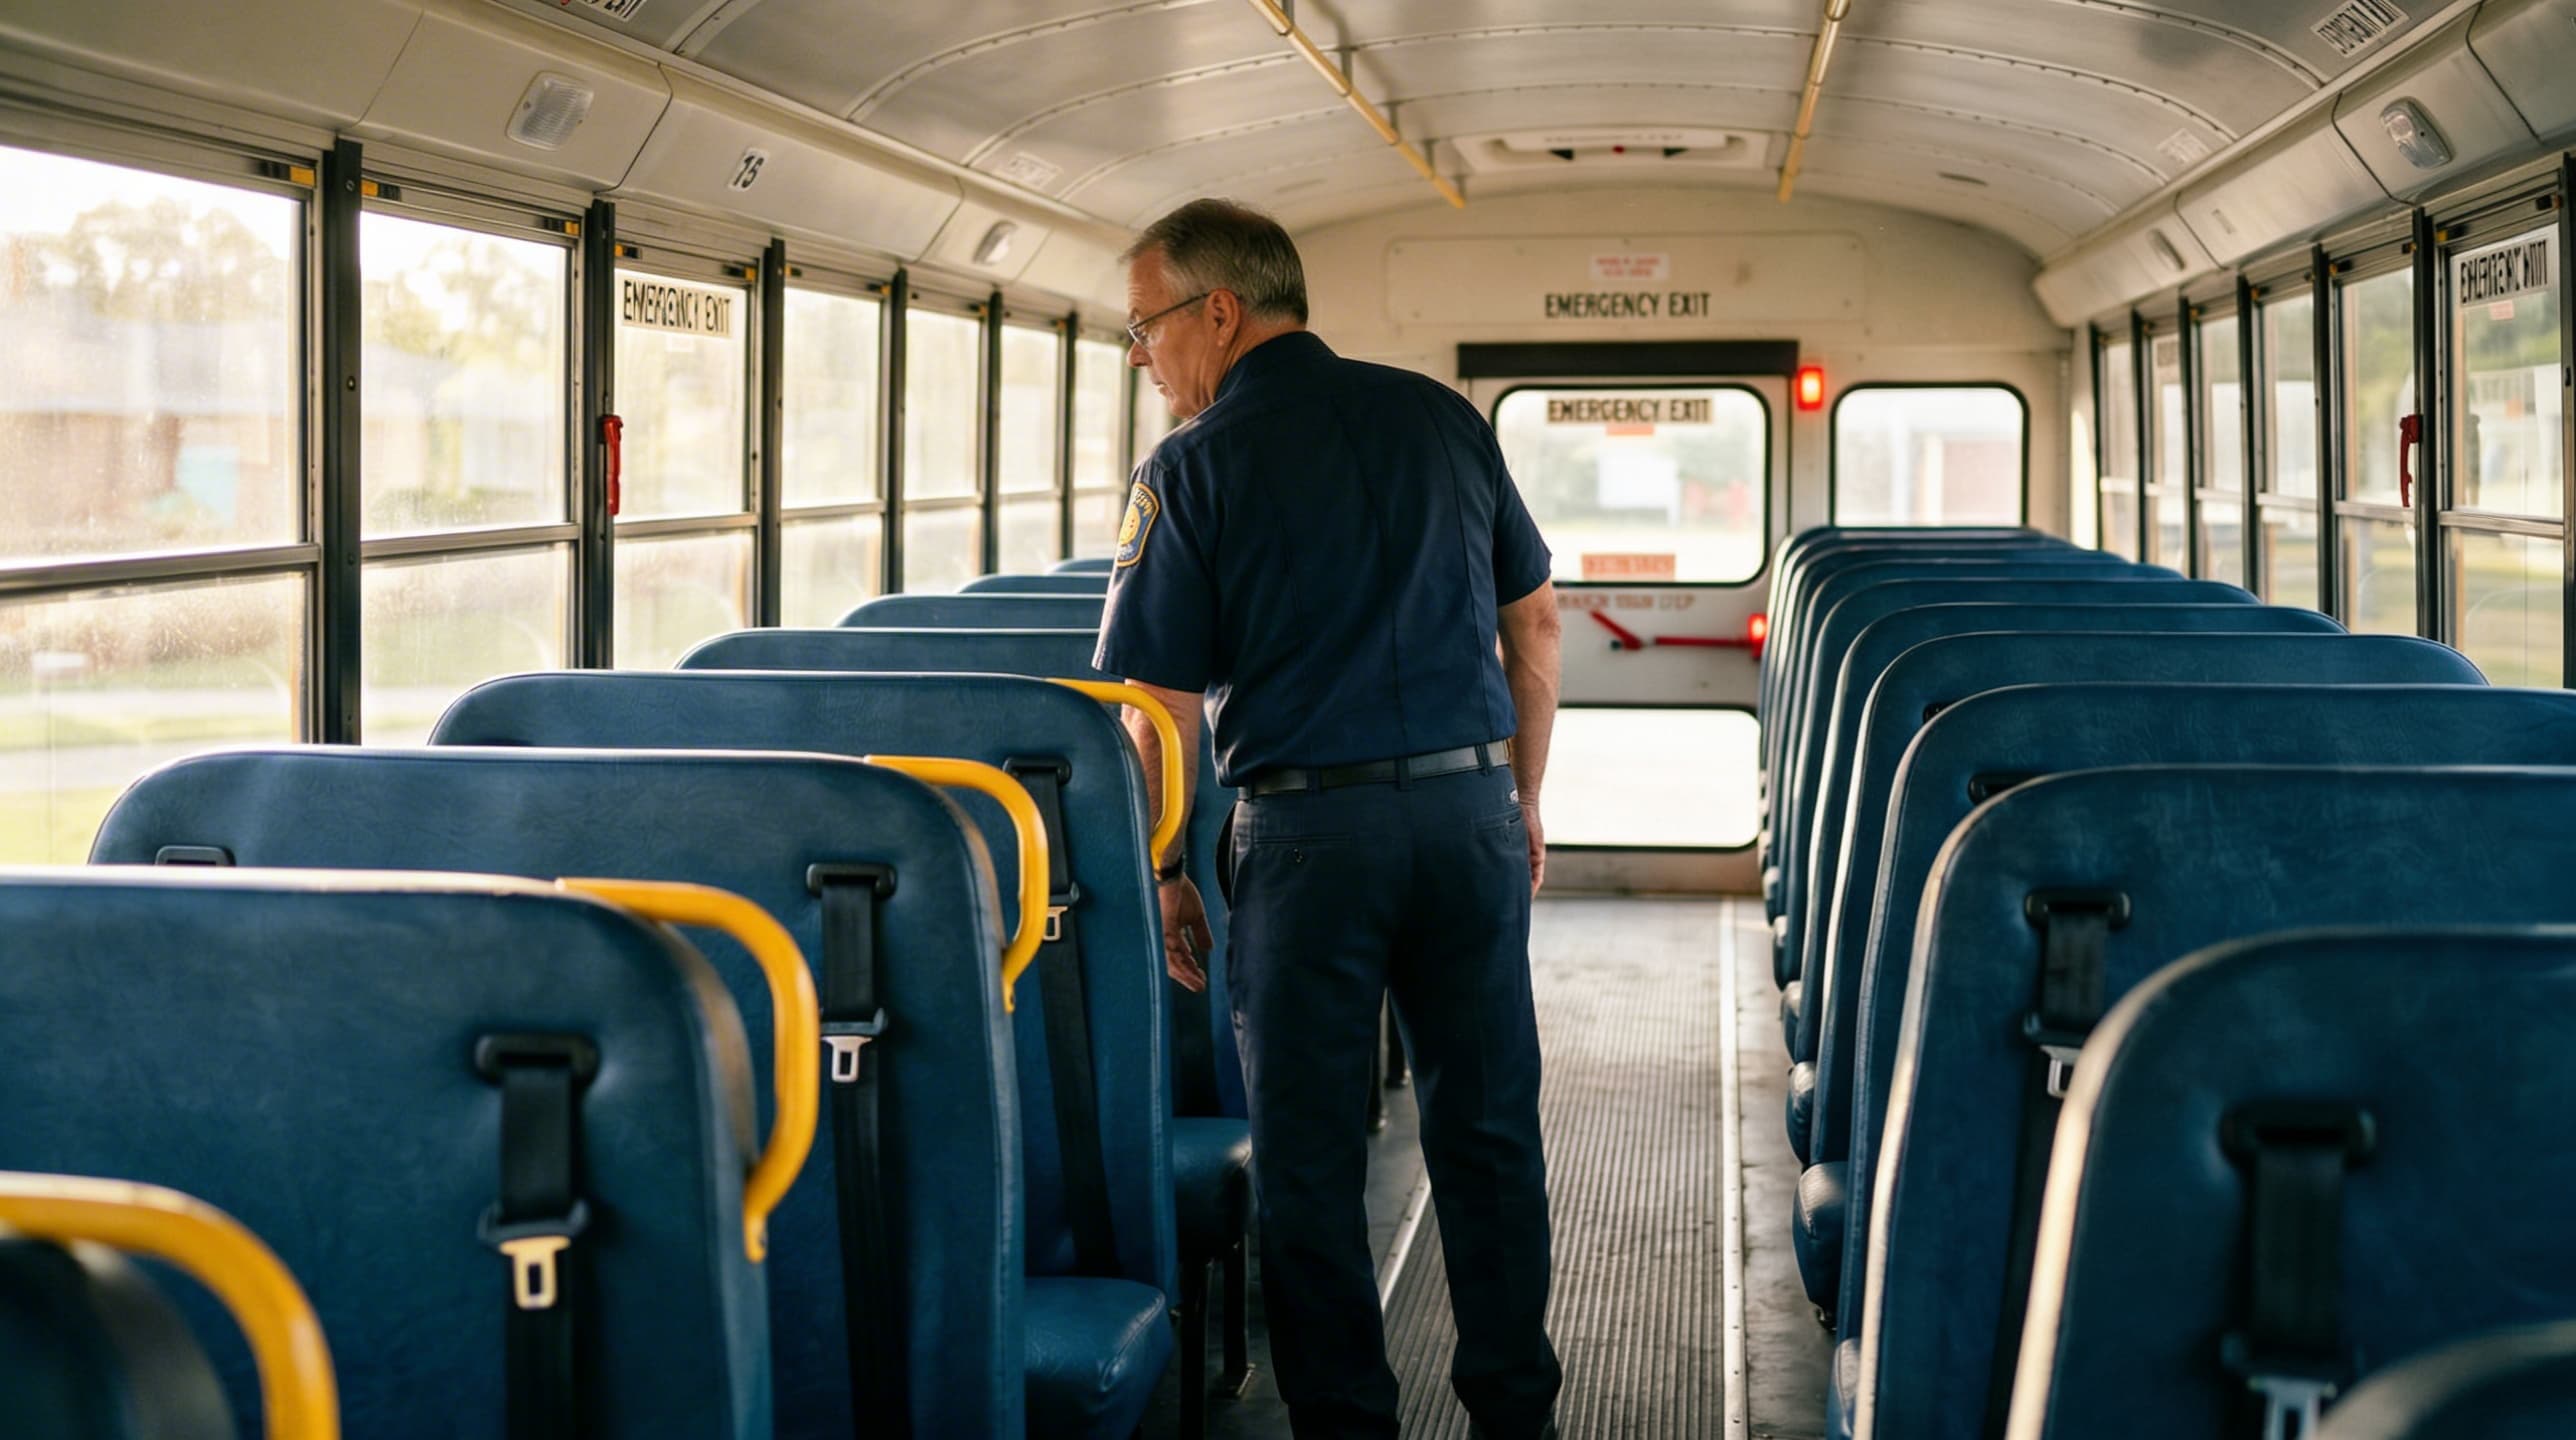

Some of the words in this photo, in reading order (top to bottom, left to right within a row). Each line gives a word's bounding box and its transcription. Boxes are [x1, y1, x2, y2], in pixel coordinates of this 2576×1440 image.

[1545, 292, 1660, 318] EMERGENCY
[1668, 291, 1711, 317] EXIT
[1549, 400, 1660, 422] EMERGENCY
[1670, 400, 1710, 422] EXIT
